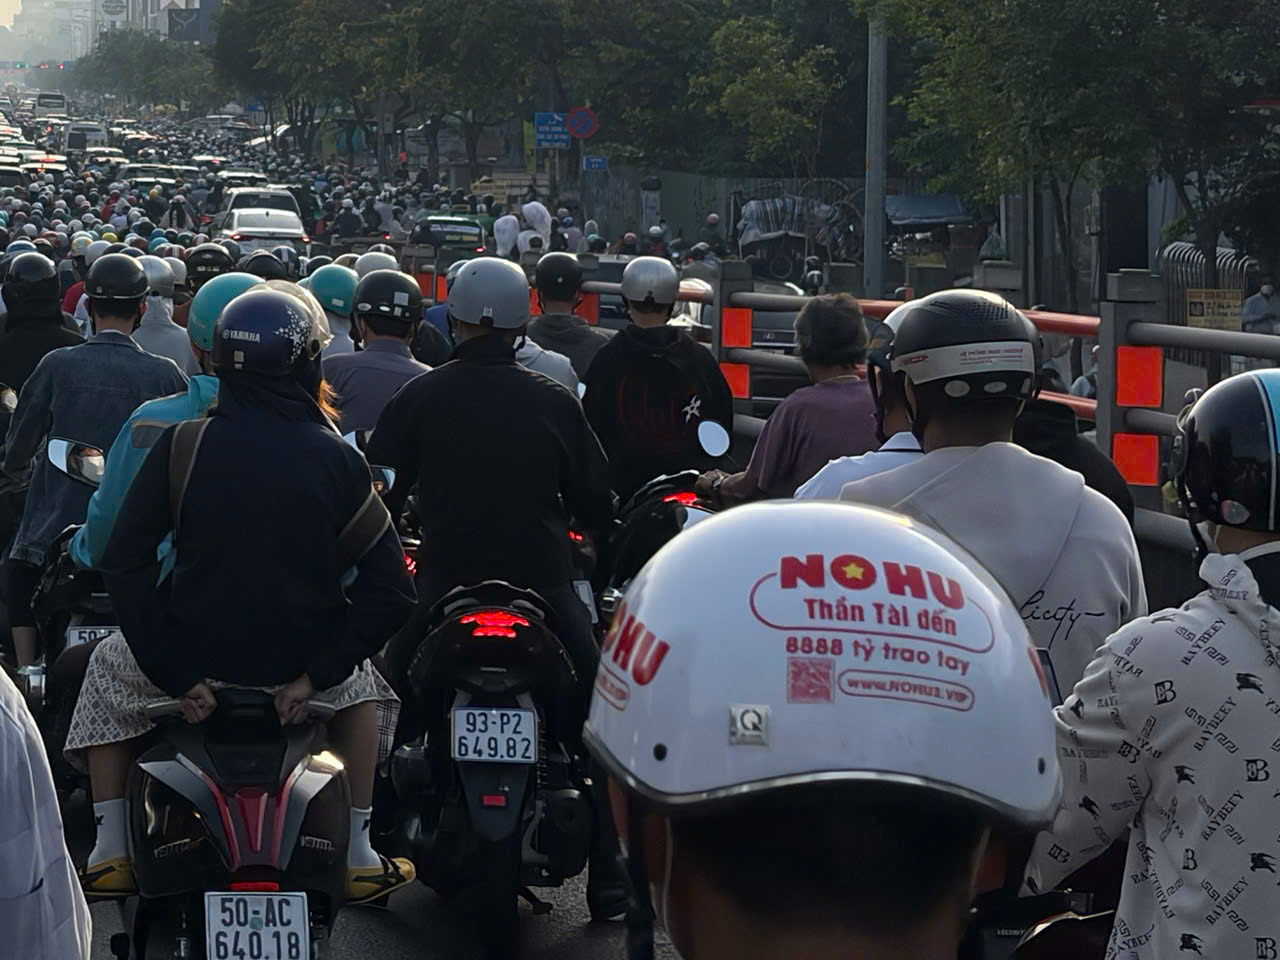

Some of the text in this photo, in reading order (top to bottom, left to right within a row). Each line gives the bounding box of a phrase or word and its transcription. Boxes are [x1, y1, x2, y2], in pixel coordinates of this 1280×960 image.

[230, 329, 261, 343] YAMAHA
[804, 596, 958, 636] Thần Tài đến
[786, 636, 843, 656] 8888
[883, 642, 930, 665] trao
[937, 650, 970, 676] tay
[465, 711, 522, 735] 93-P2
[458, 736, 532, 760] 649.82
[220, 898, 292, 927] 50-AC
[215, 930, 300, 960] 640.18
